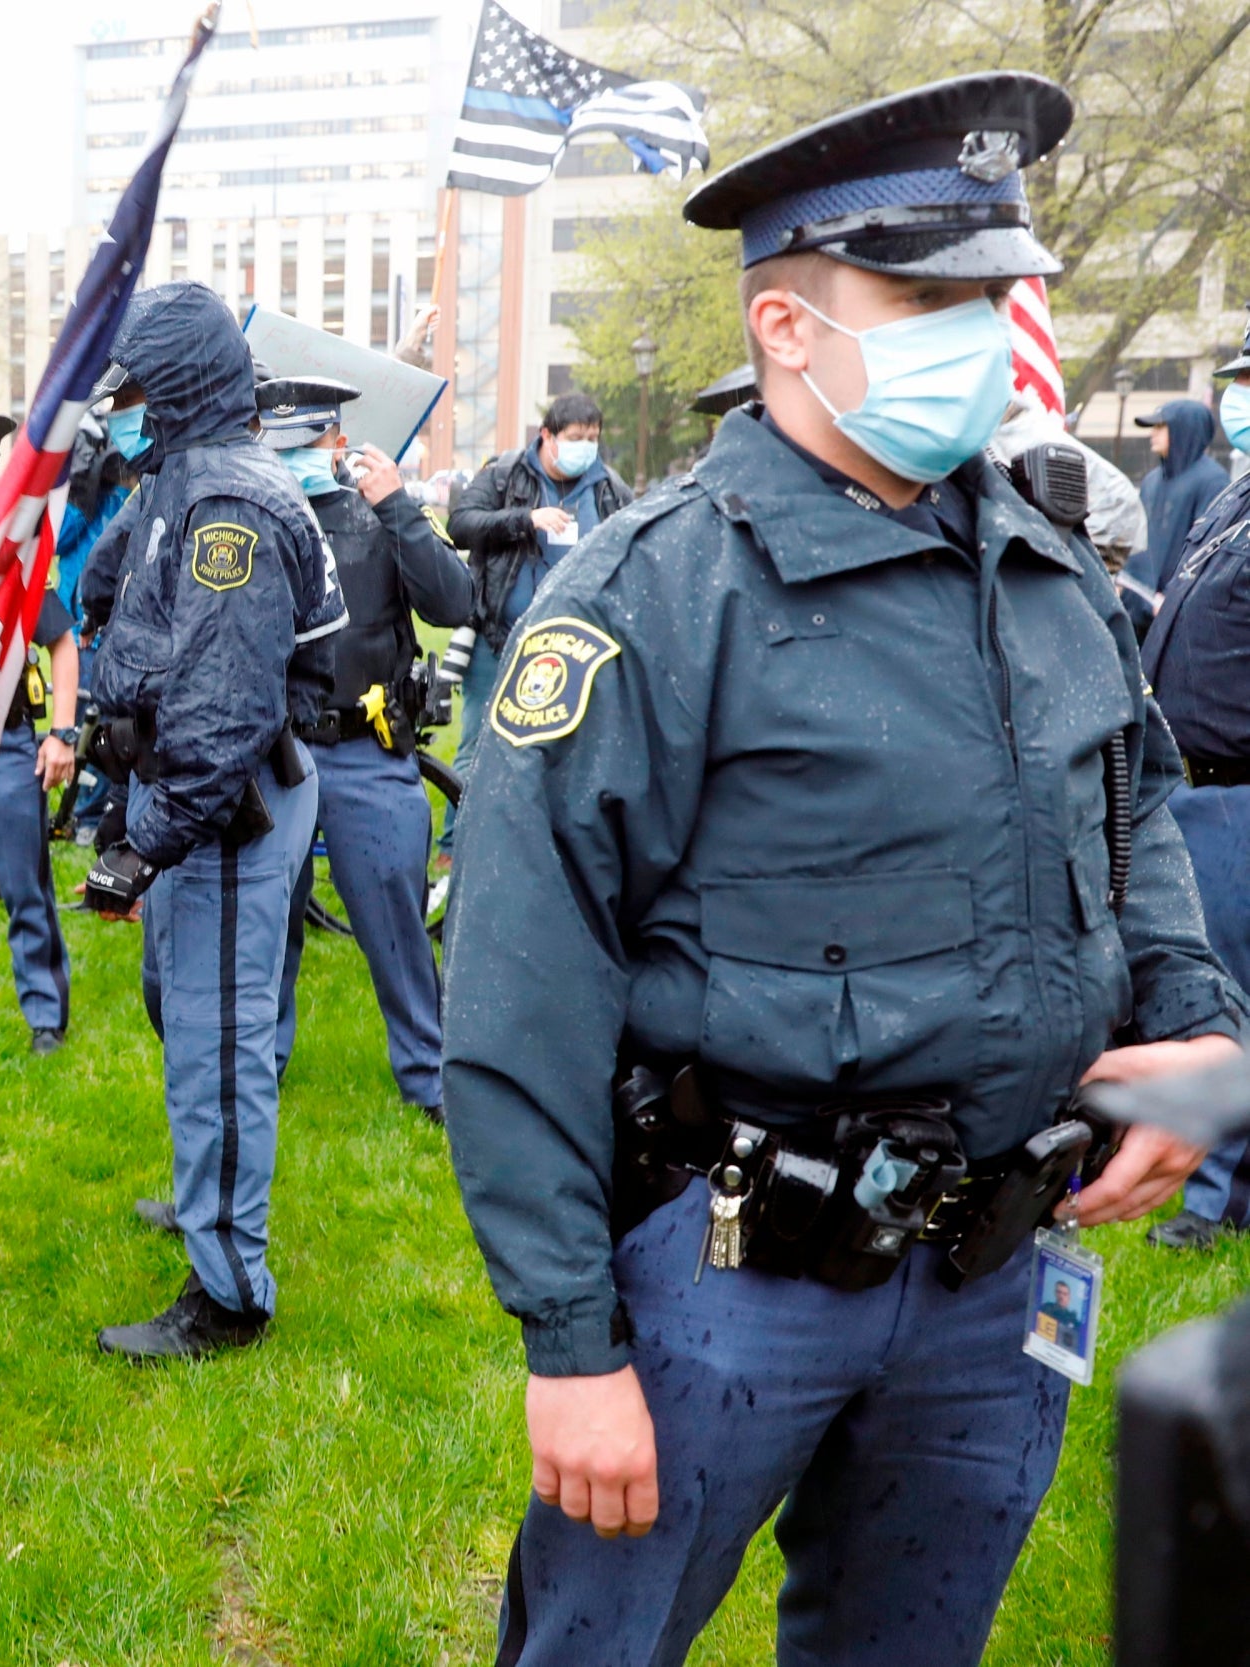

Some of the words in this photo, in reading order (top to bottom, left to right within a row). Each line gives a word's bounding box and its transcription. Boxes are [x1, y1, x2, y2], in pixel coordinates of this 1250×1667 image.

[203, 530, 246, 547] MICHIGAN
[523, 632, 598, 664] MICHIGAN
[523, 703, 569, 728] POLICE
